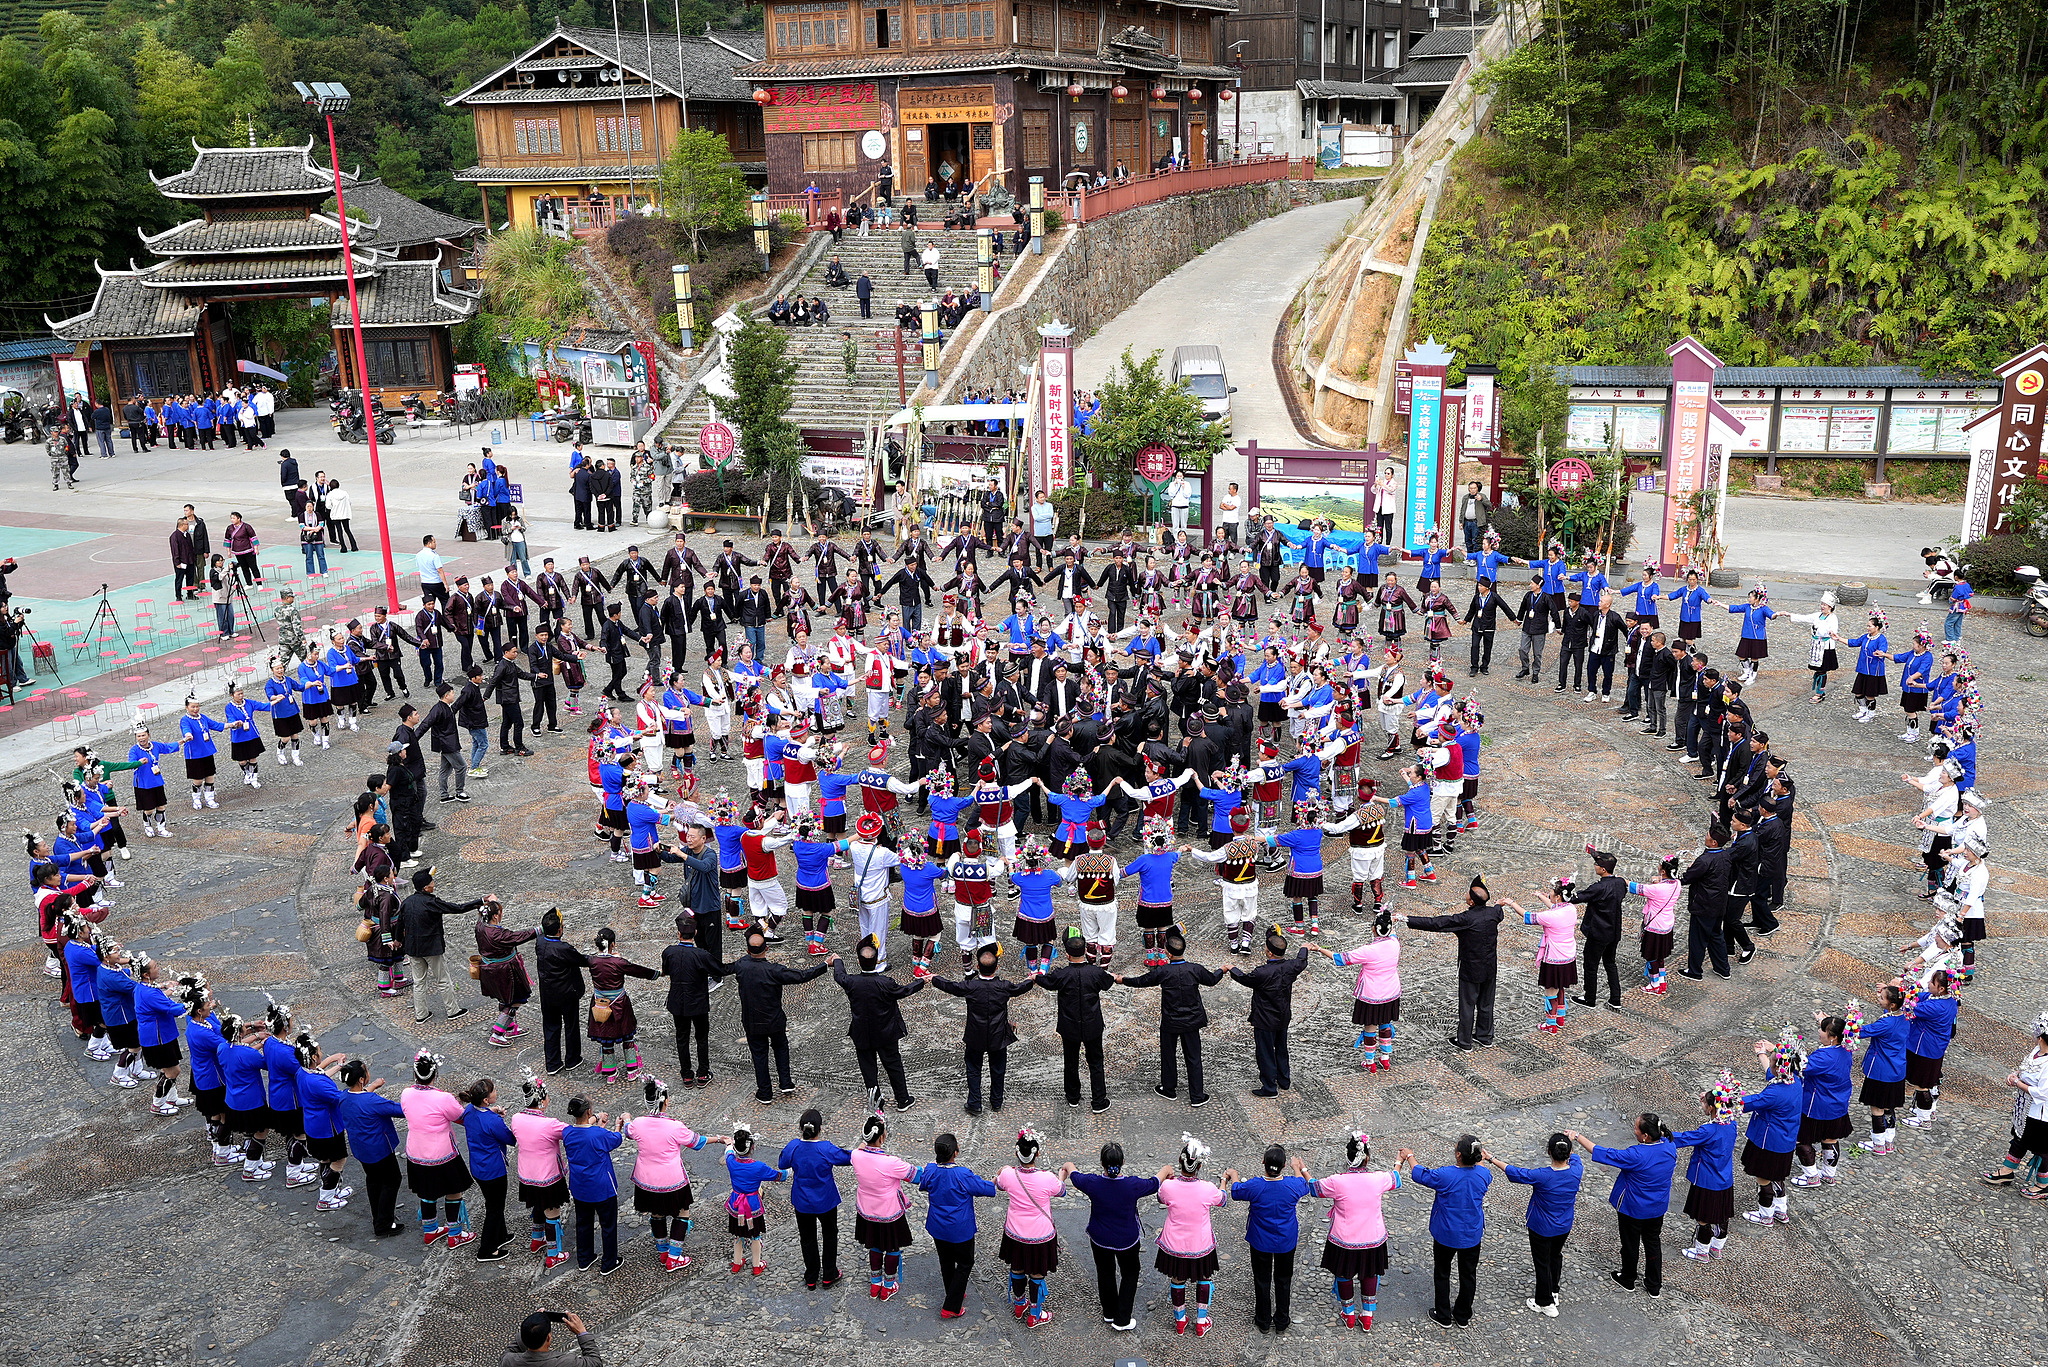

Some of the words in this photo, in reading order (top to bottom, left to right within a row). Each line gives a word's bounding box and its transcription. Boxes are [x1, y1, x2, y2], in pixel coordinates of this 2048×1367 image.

[1591, 389, 1645, 398] 八江镇
[1714, 389, 1723, 398] 村
[1741, 389, 1766, 399] 党务
[1792, 390, 1822, 399] 村务
[1847, 390, 1875, 399] 财务
[1916, 390, 1975, 399] 公开栏
[1471, 394, 1485, 432] 信用村
[1147, 453, 1164, 462] 文明
[1147, 462, 1164, 471] 和谐
[1413, 404, 1431, 546] 支持茶叶产业发展示范基地
[1561, 470, 1579, 480] 自由
[1560, 480, 1579, 490] 平等
